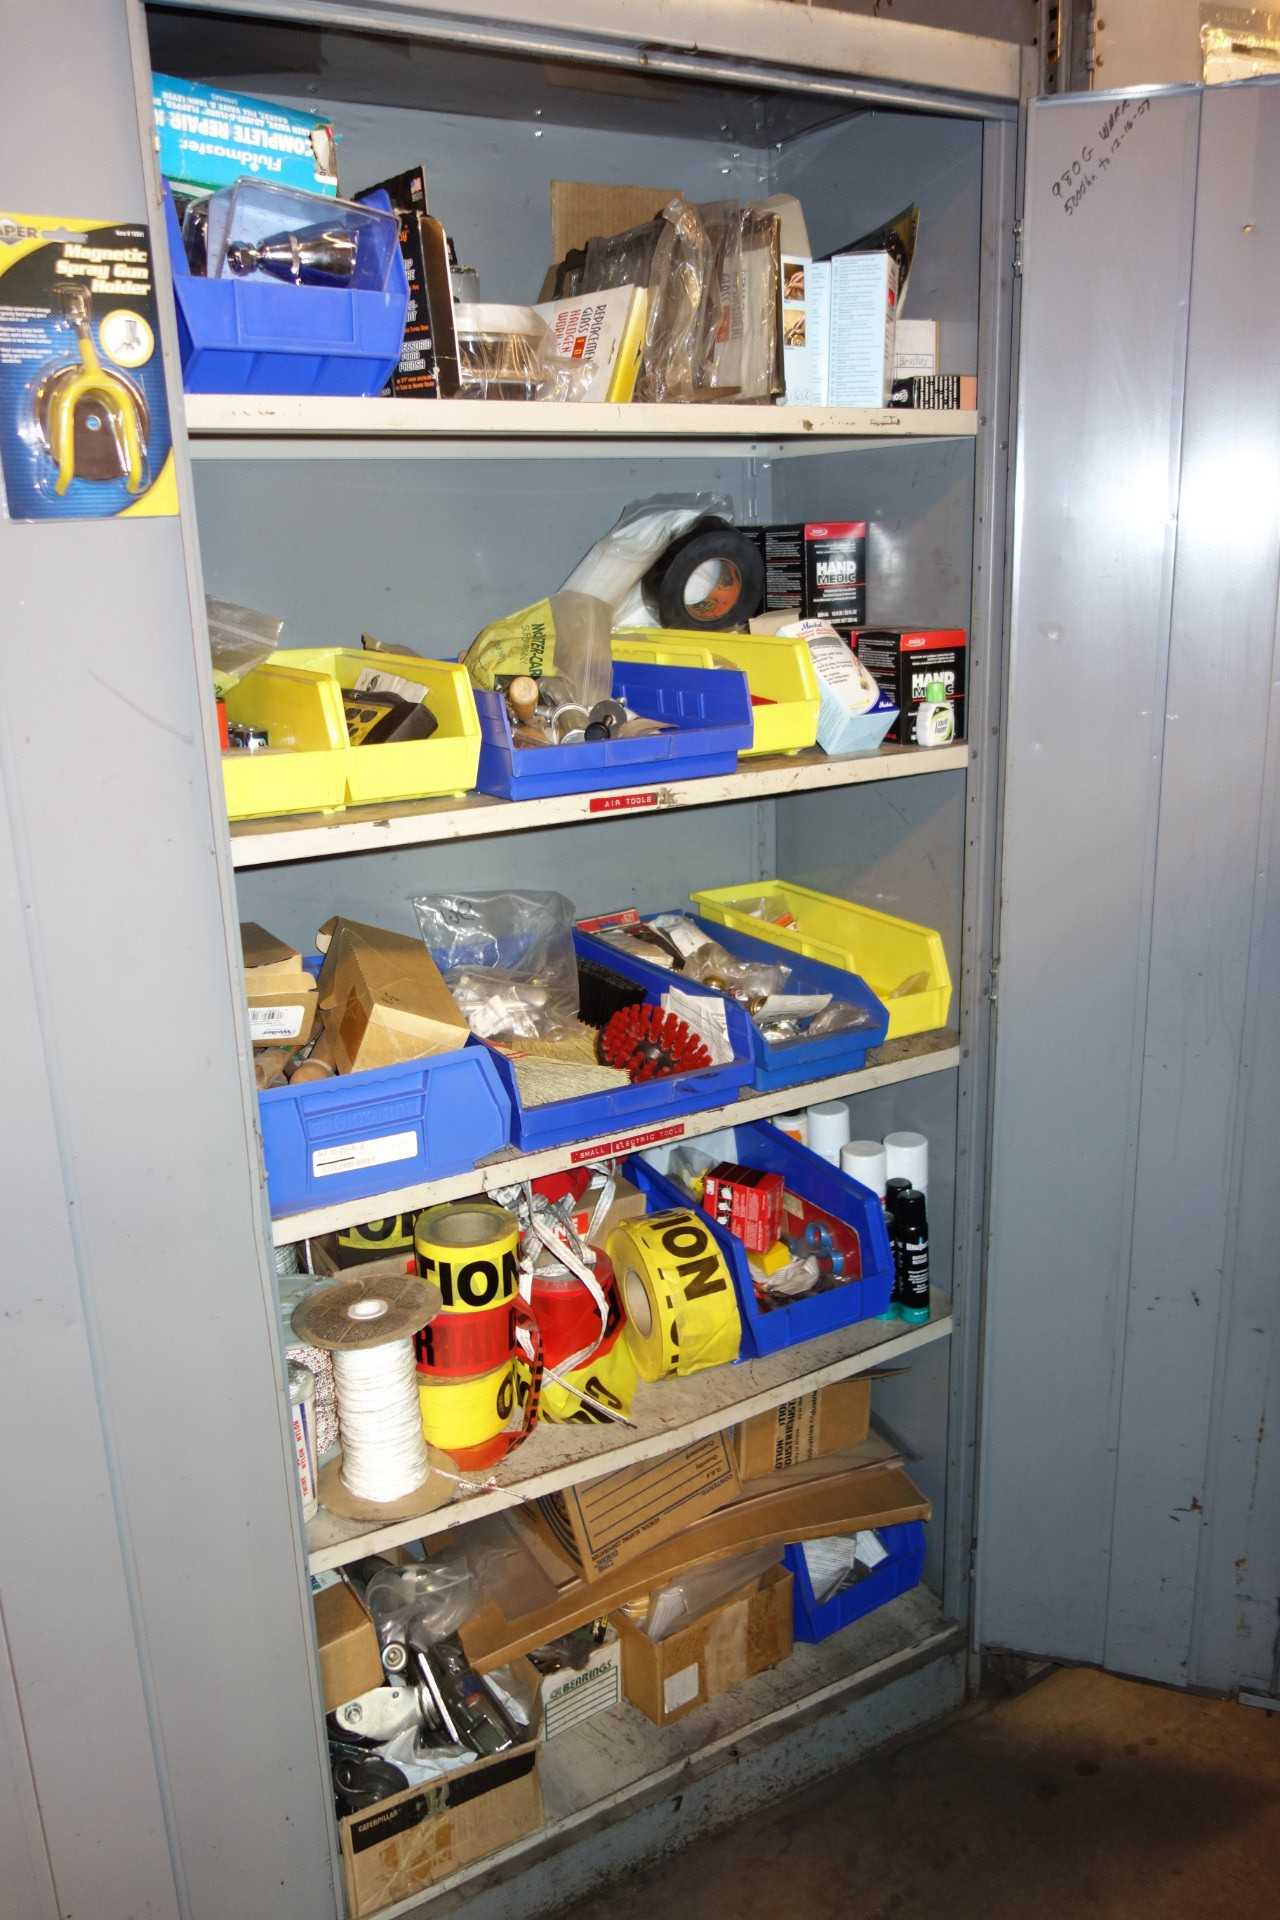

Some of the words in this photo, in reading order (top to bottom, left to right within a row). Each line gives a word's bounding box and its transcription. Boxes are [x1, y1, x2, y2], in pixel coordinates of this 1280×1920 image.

[169, 111, 230, 141] REPAIR
[233, 126, 314, 157] COMPLETE
[178, 138, 283, 173] Fluidmaster
[63, 243, 148, 263] Magnetic
[55, 259, 110, 279] Spray
[113, 262, 149, 279] Gun
[91, 279, 151, 296] Holder
[816, 560, 857, 575] HAND
[817, 573, 857, 585] MEDIC
[912, 671, 955, 688] HAND
[604, 799, 621, 808] AIR
[580, 1147, 605, 1159] SMALL
[615, 1133, 656, 1150] ELECTRIC
[562, 1659, 613, 1695] BEARINGS
[358, 1808, 399, 1833] CATERPILLAR
